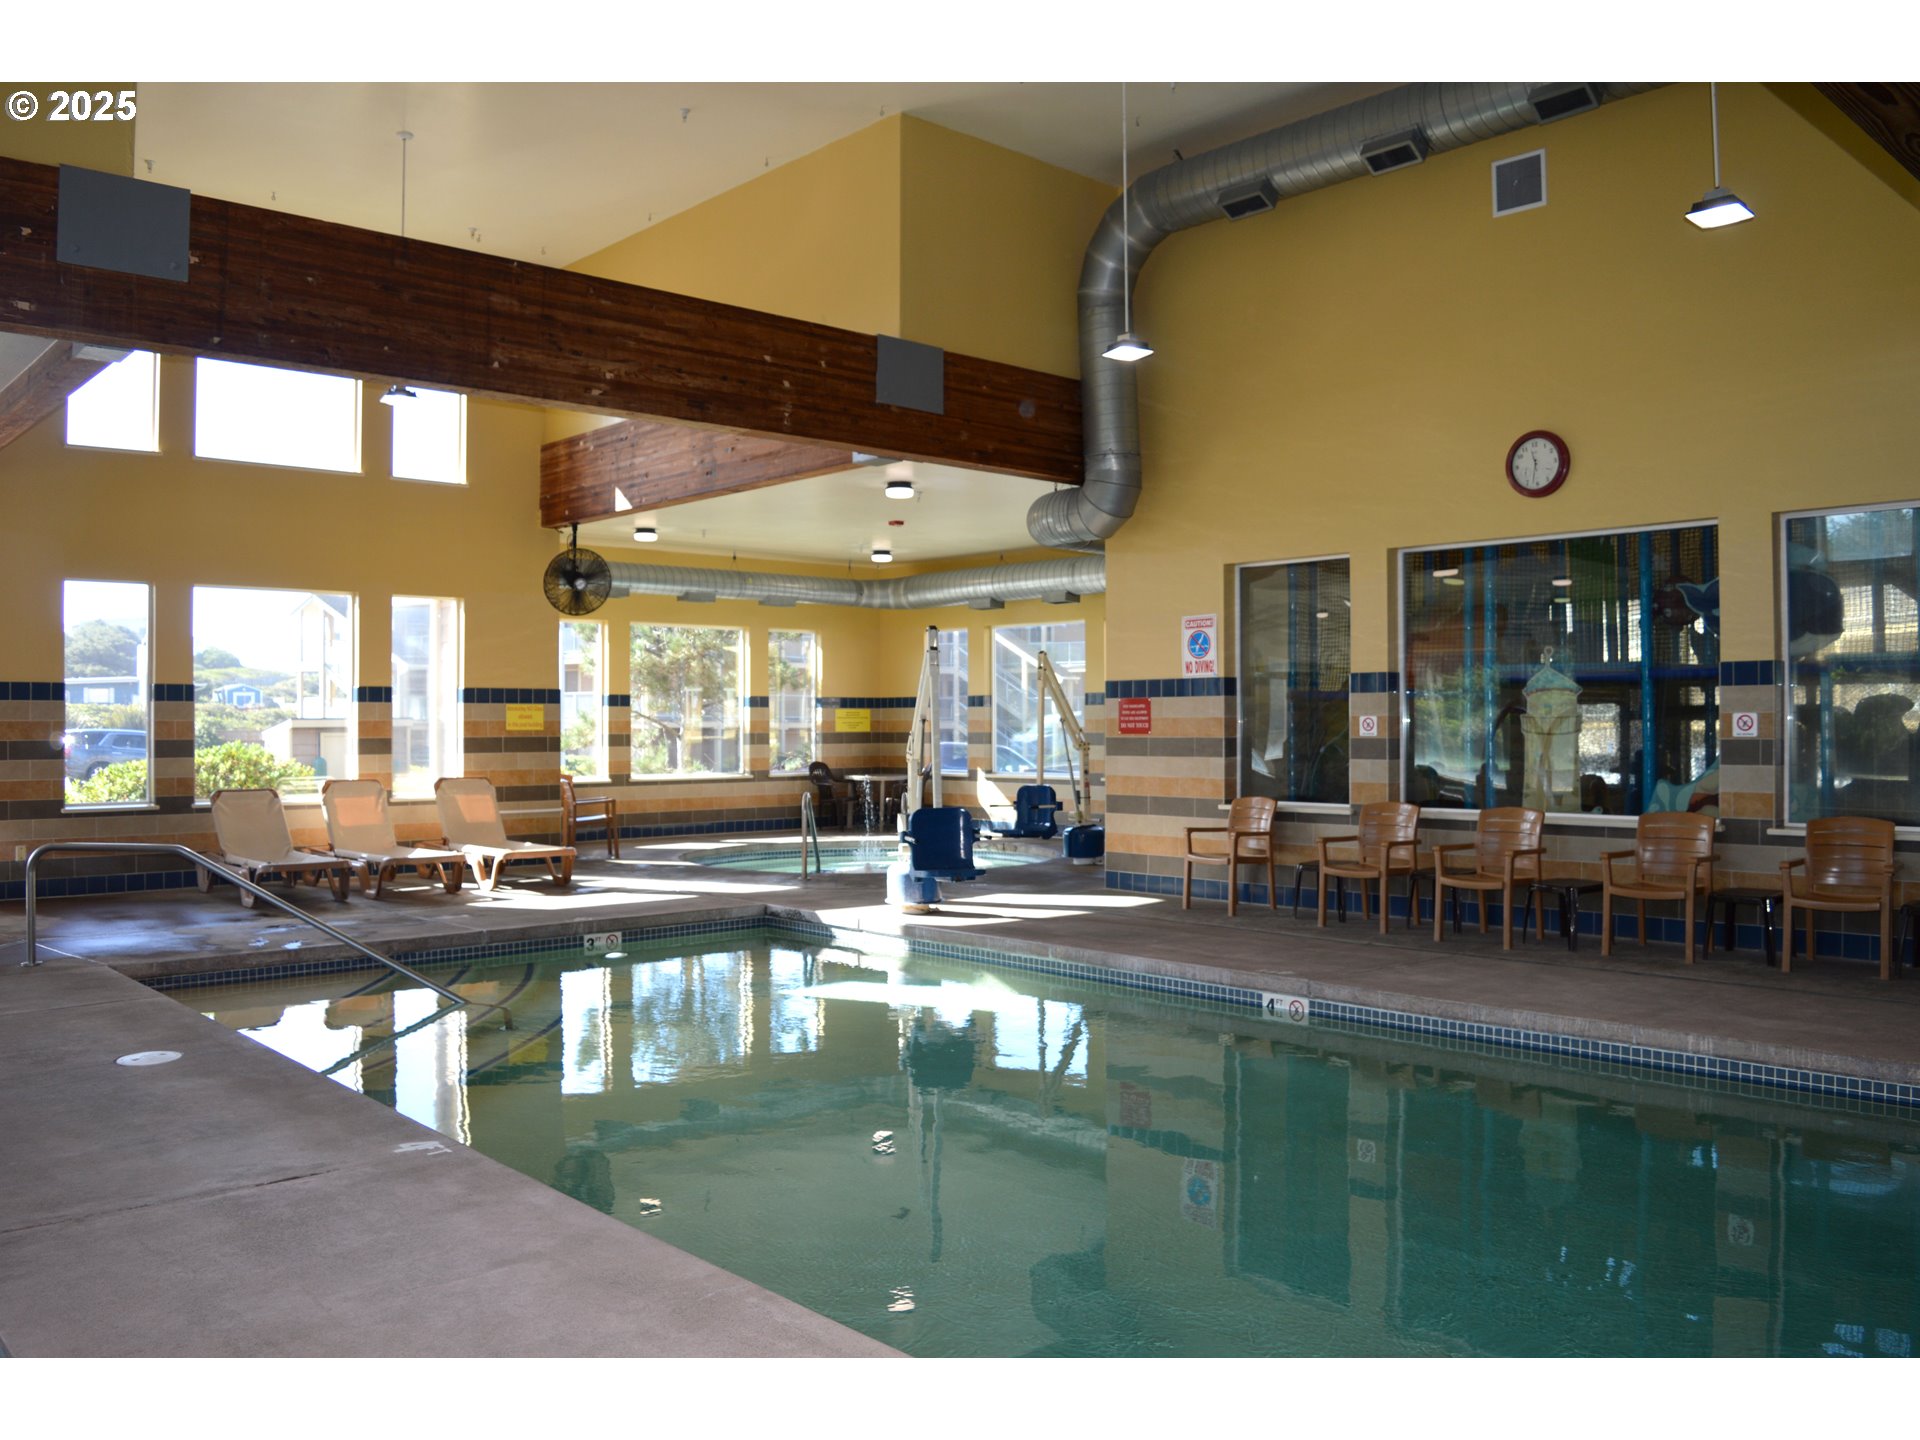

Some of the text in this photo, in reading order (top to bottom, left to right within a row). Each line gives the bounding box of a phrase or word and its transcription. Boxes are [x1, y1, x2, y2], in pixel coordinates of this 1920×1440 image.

[1185, 660, 1214, 674] NO DIVING!
[586, 938, 594, 950] 3
